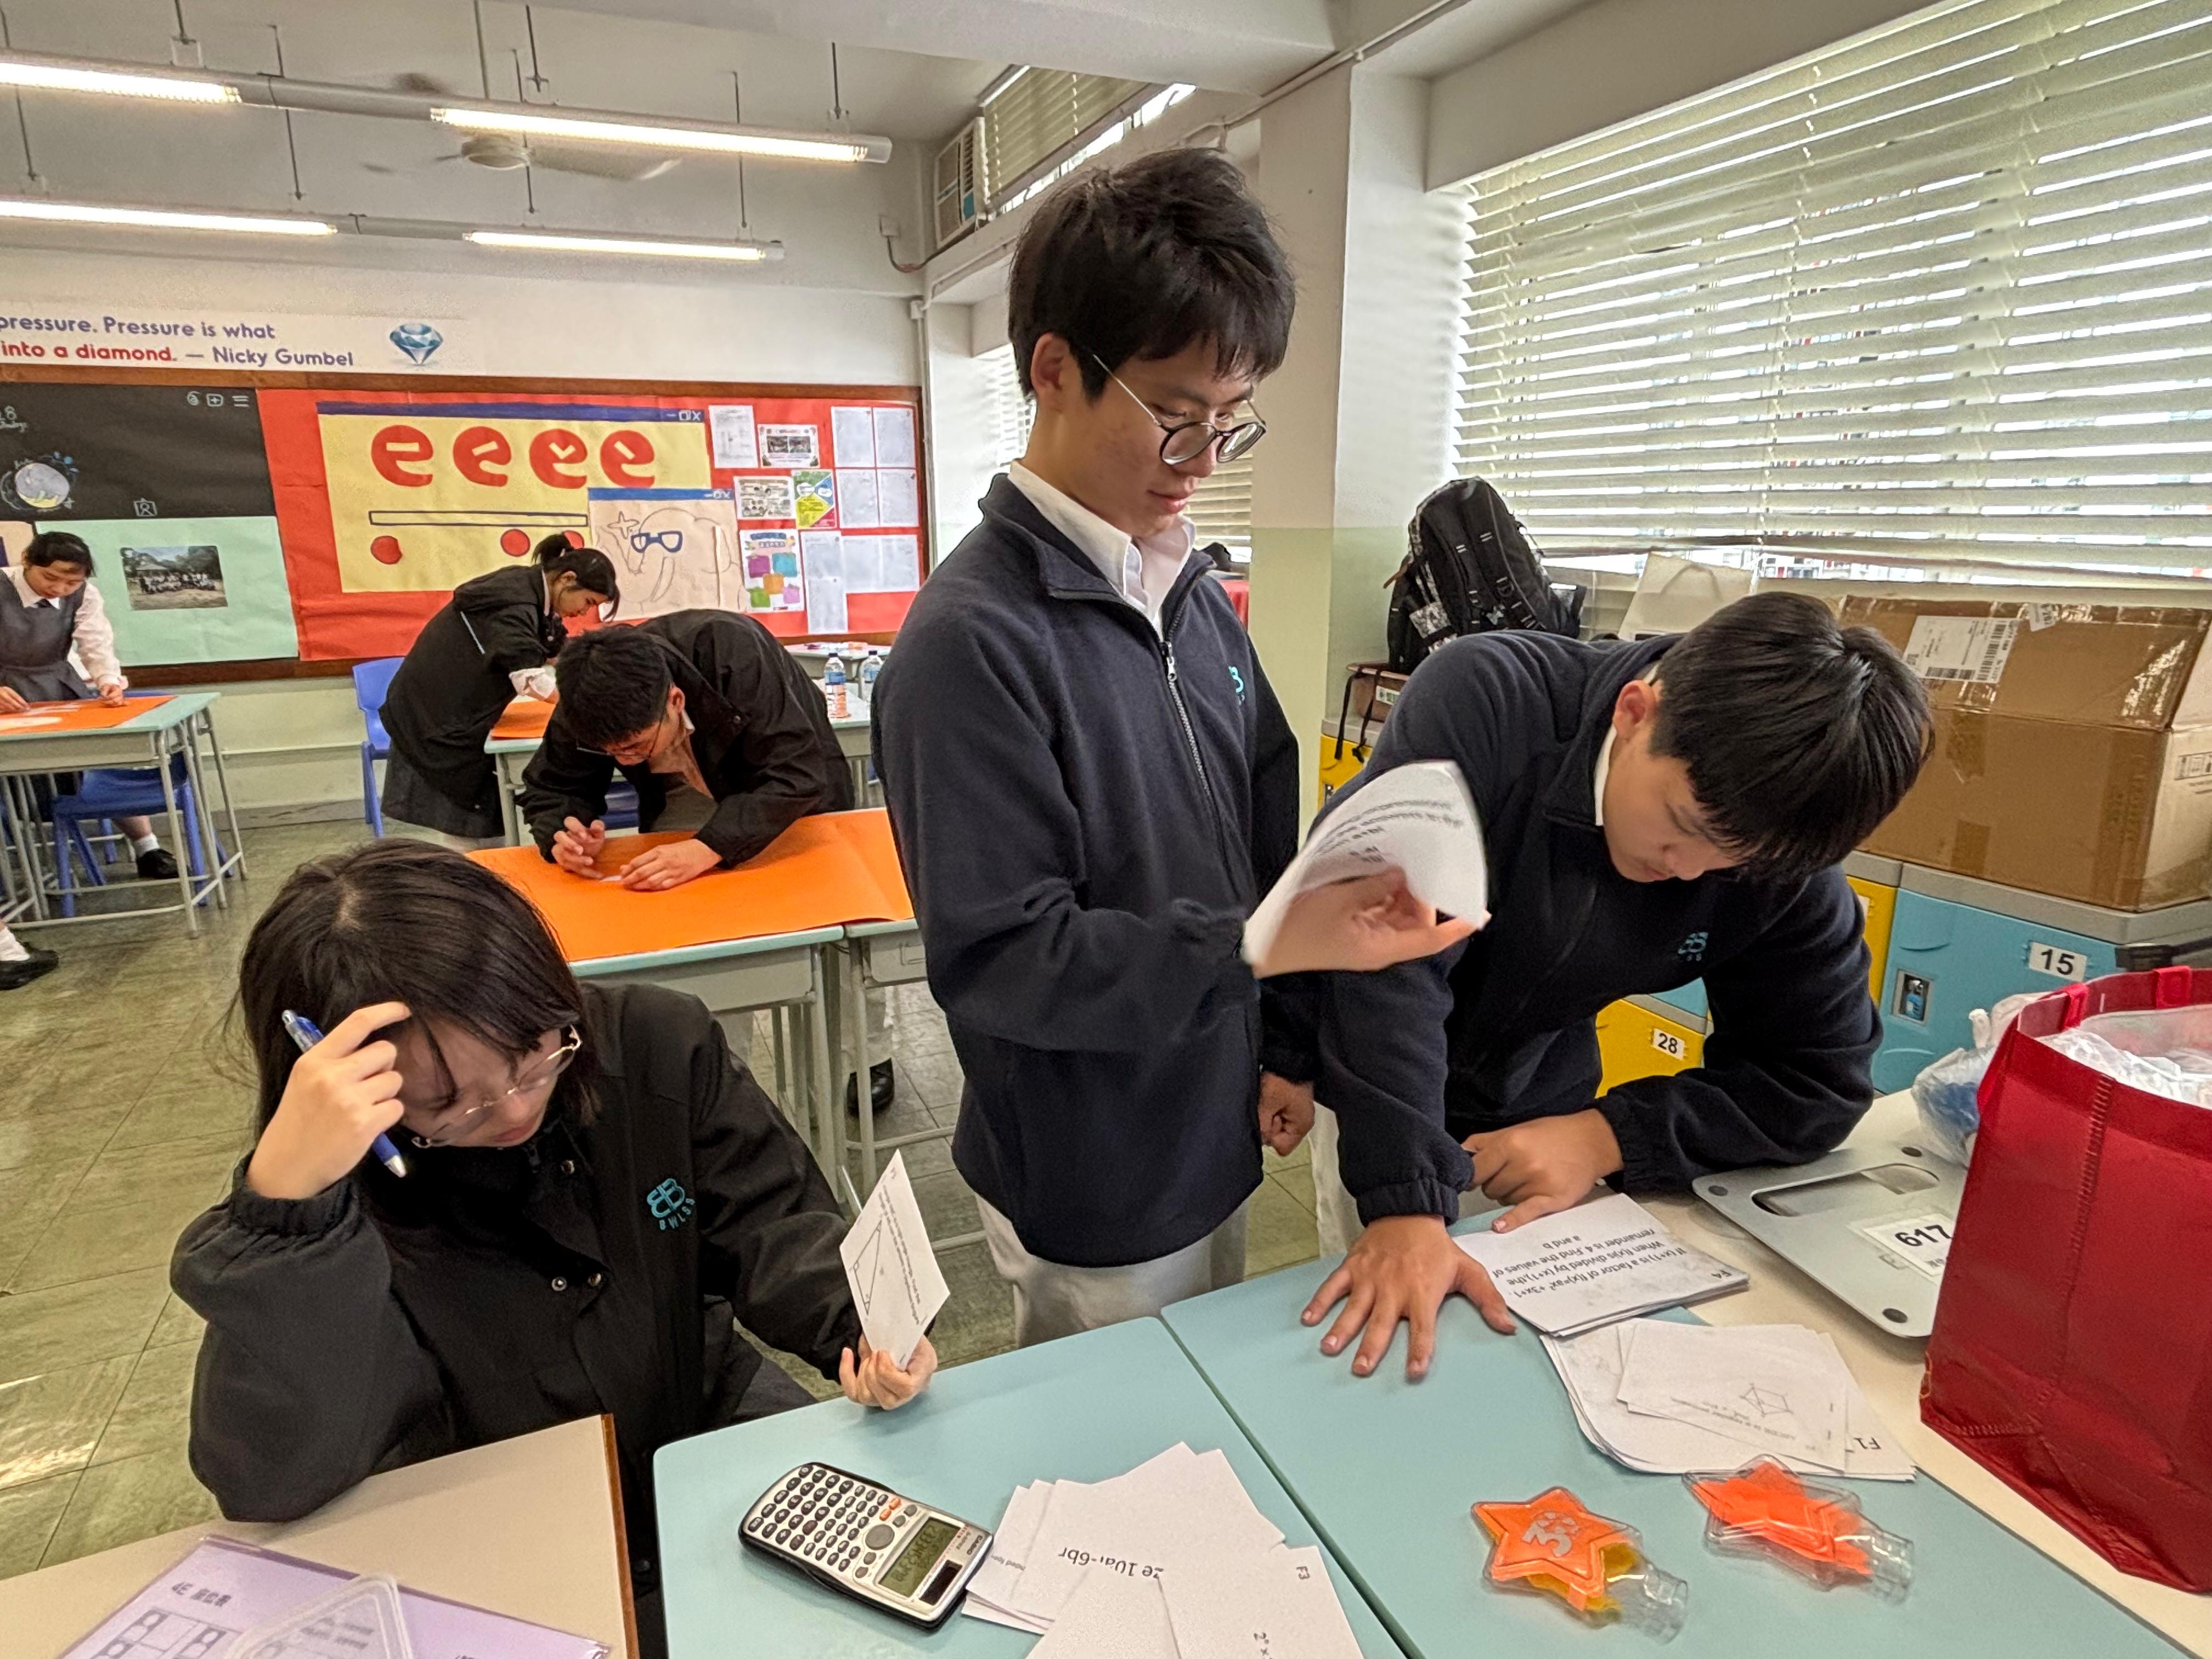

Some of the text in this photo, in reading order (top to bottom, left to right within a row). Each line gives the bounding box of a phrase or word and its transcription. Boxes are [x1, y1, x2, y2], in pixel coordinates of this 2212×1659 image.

[103, 316, 195, 336] Pressure
[201, 321, 216, 337] is
[223, 323, 275, 338] what
[1, 341, 45, 357] into
[54, 346, 68, 357] a
[76, 343, 177, 361] diamond.
[212, 346, 268, 367] Nicky
[275, 348, 353, 366] Gumbel
[2041, 949, 2074, 975] 15
[1658, 1033, 1677, 1054] 28
[1604, 1229, 1656, 1246] remainder
[1895, 1225, 1953, 1246] 617
[1551, 1237, 1572, 1248] and
[1632, 1240, 1665, 1252] When
[1539, 1254, 1560, 1263] the
[1569, 1254, 1607, 1269] divided
[1504, 1260, 1540, 1272] values
[1601, 1262, 1633, 1274] factor
[1492, 1269, 1504, 1278] of
[1587, 1271, 1599, 1279] of
[1854, 1437, 1881, 1449] F1
[967, 1535, 983, 1555] CASIO
